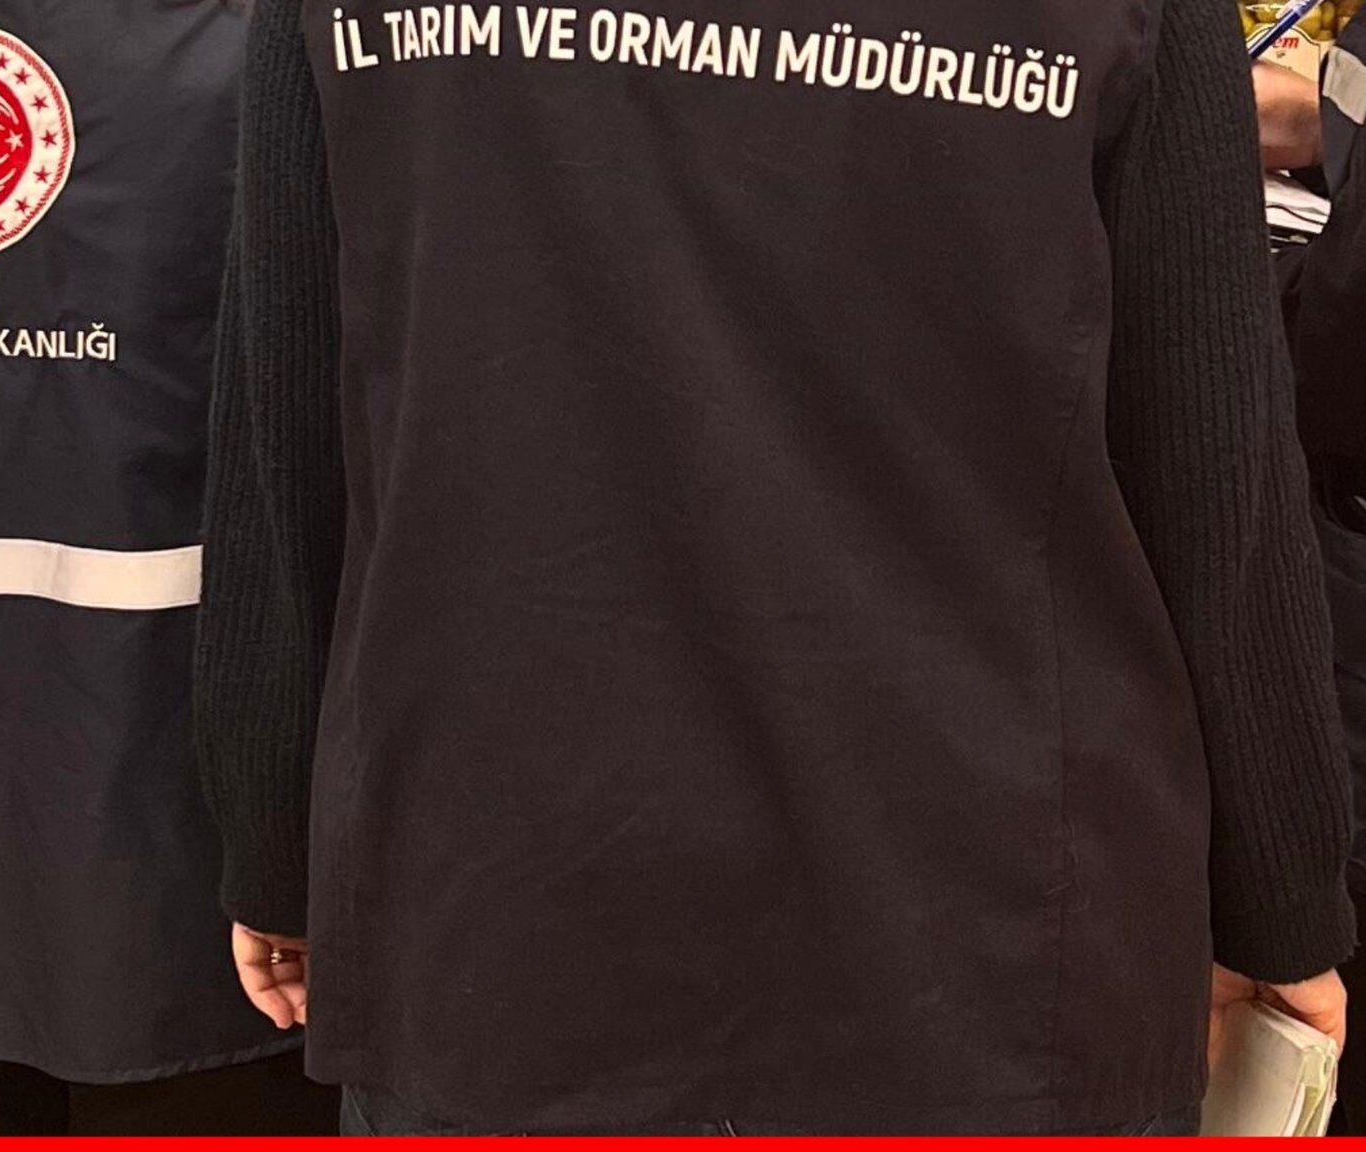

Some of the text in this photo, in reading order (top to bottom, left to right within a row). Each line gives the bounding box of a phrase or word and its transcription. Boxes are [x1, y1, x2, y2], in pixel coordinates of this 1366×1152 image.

[333, 4, 1080, 119] İL TARIM VE ORMAN MÜDÜRLÜĞÜ
